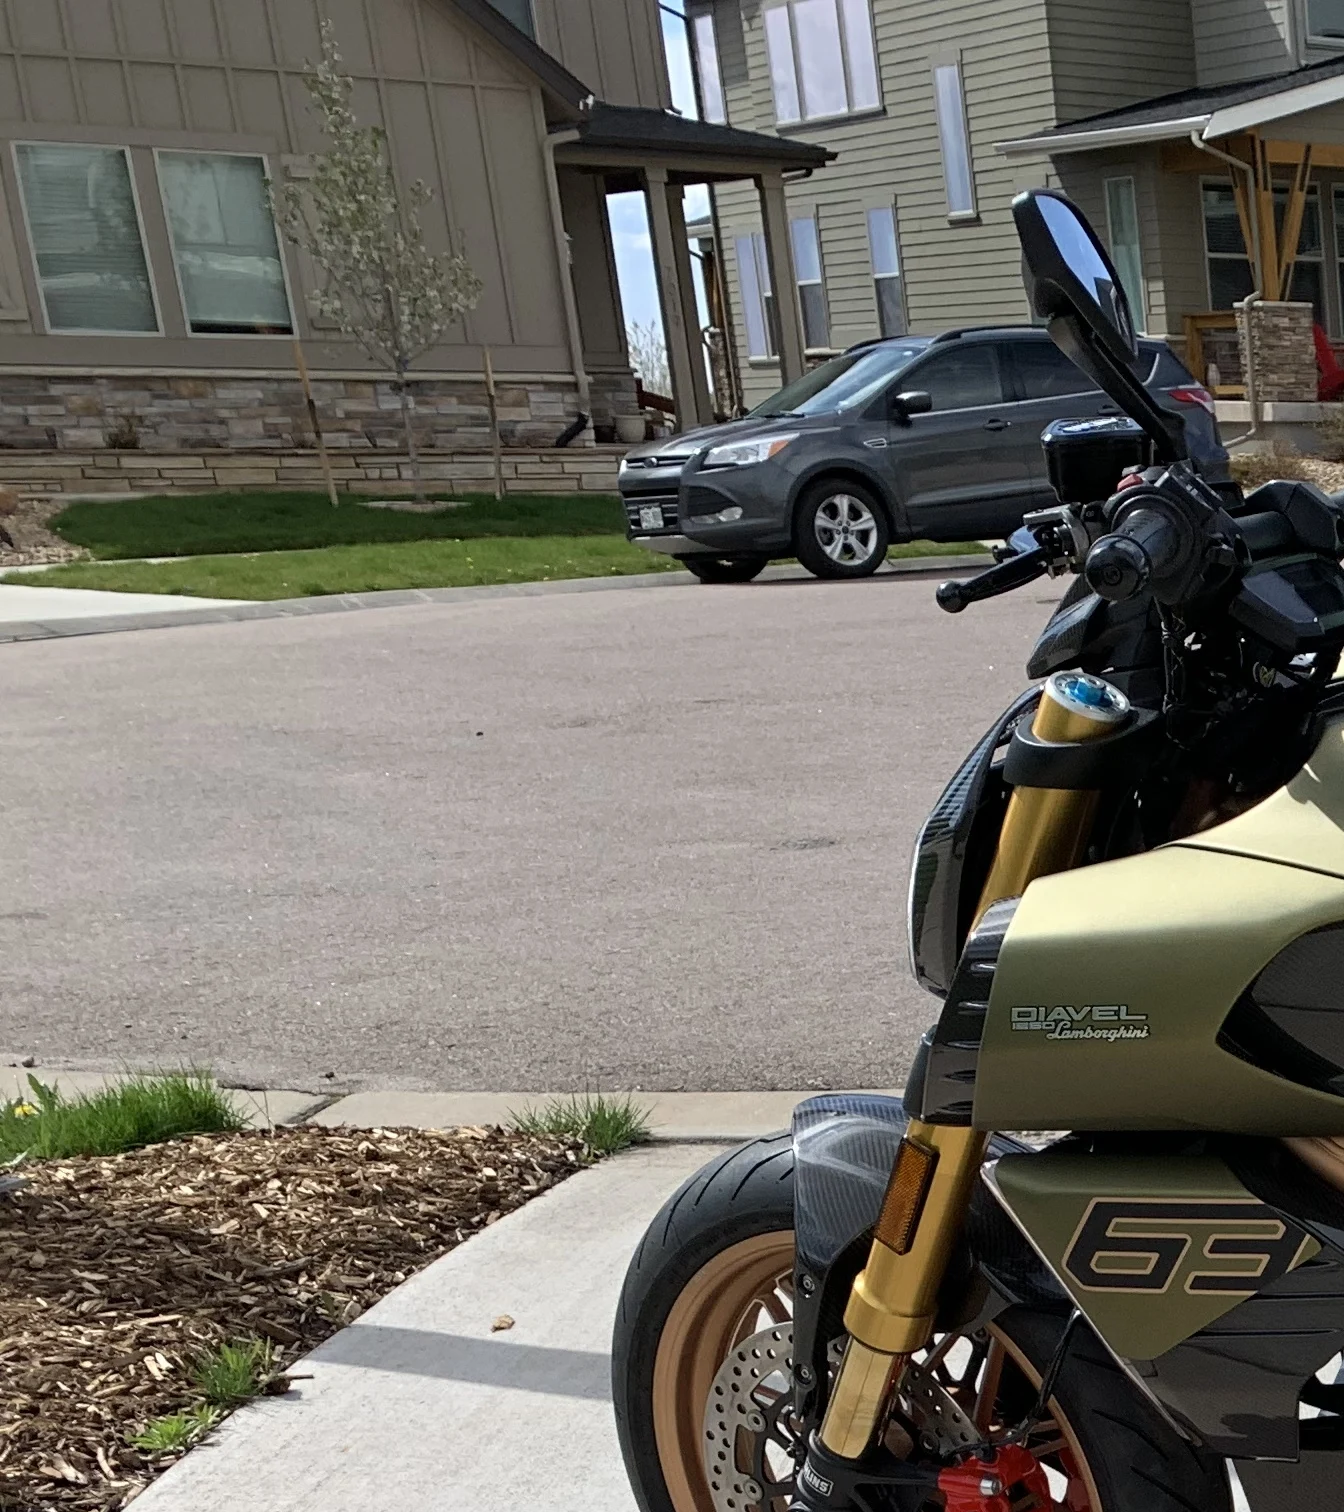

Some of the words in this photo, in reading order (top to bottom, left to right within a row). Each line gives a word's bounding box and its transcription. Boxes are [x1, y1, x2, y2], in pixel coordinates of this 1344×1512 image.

[1010, 1005, 1148, 1022] DIAVEL
[1046, 1020, 1150, 1042] Lamborghini
[1062, 1197, 1311, 1295] 63
